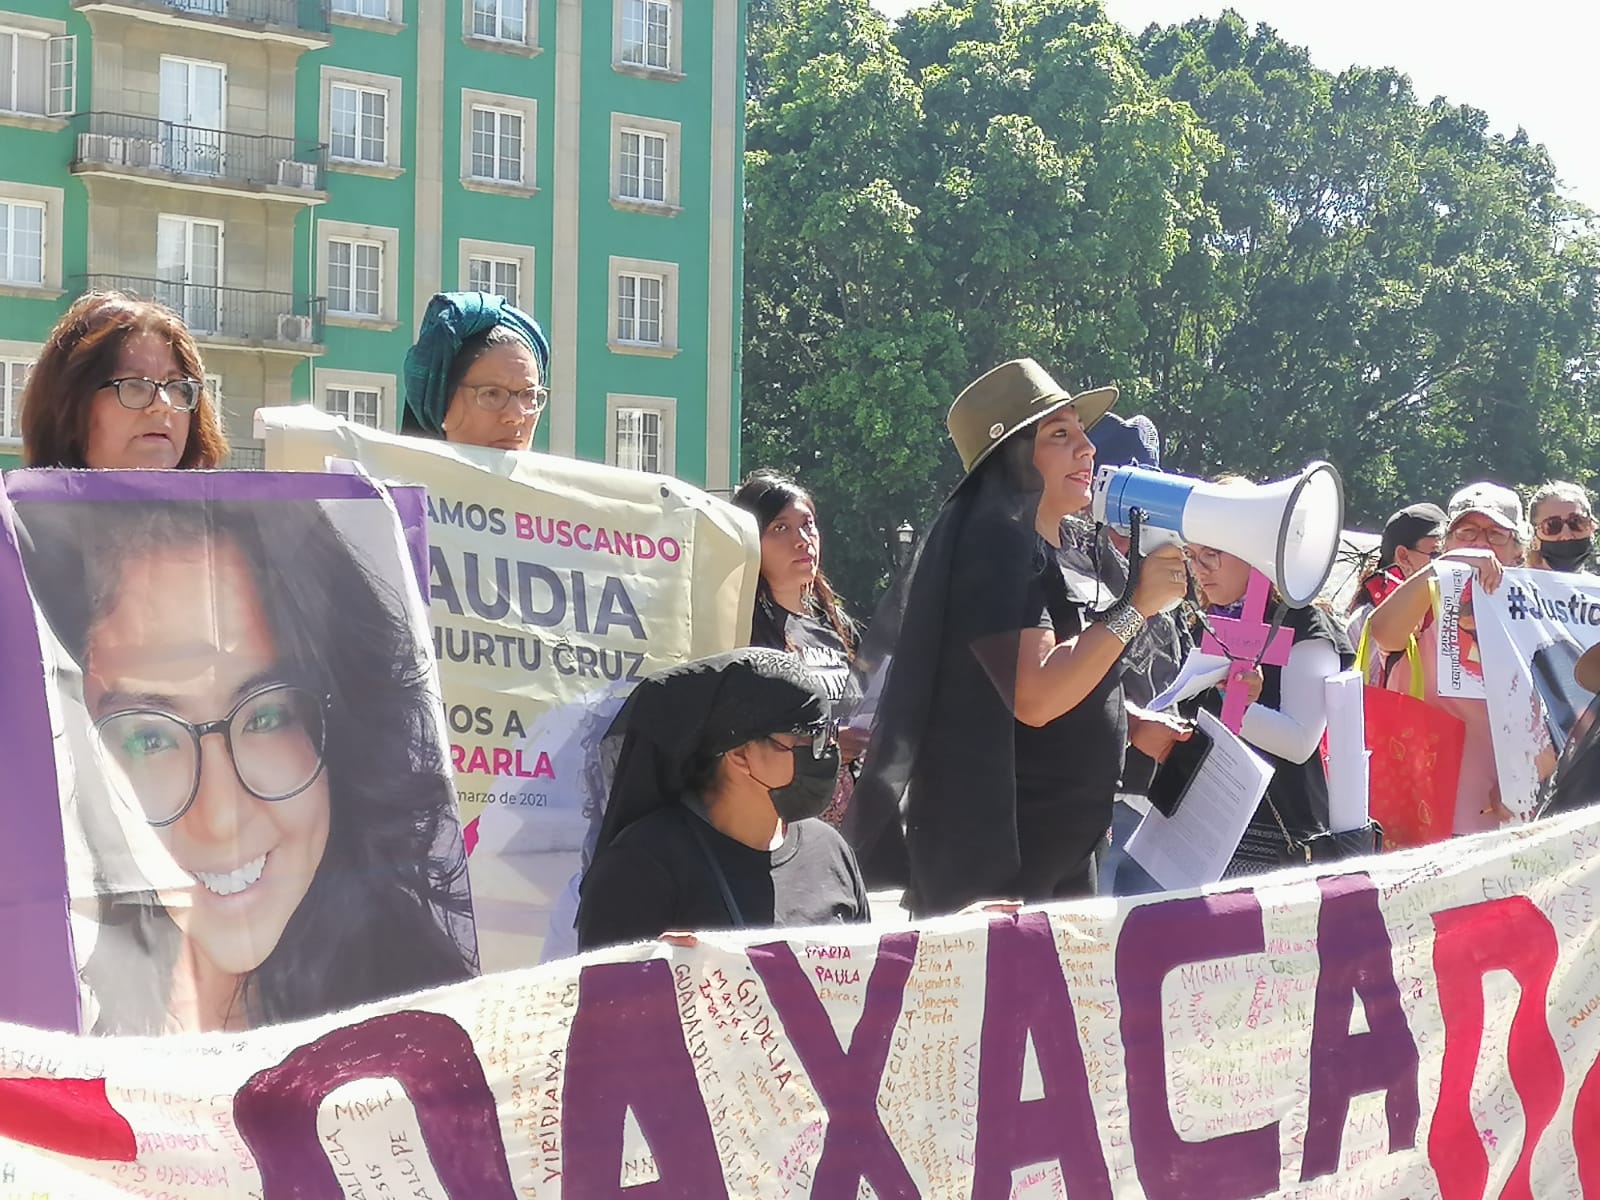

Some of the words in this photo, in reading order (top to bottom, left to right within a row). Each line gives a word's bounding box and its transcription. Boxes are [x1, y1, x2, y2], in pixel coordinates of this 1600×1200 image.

[515, 512, 681, 562] BUSCANDO
[429, 545, 648, 640] AUDIA
[552, 643, 644, 682] CRUZ
[443, 703, 493, 735] OS
[503, 710, 526, 738] A
[450, 744, 556, 780] RARLA
[500, 792, 516, 805] de
[520, 793, 547, 807] 2021
[815, 965, 860, 985] PAULA
[235, 868, 1420, 1200] OAXACA
[542, 1048, 564, 1184] VIRIDIANA
[957, 1042, 977, 1167] EUGENIA
